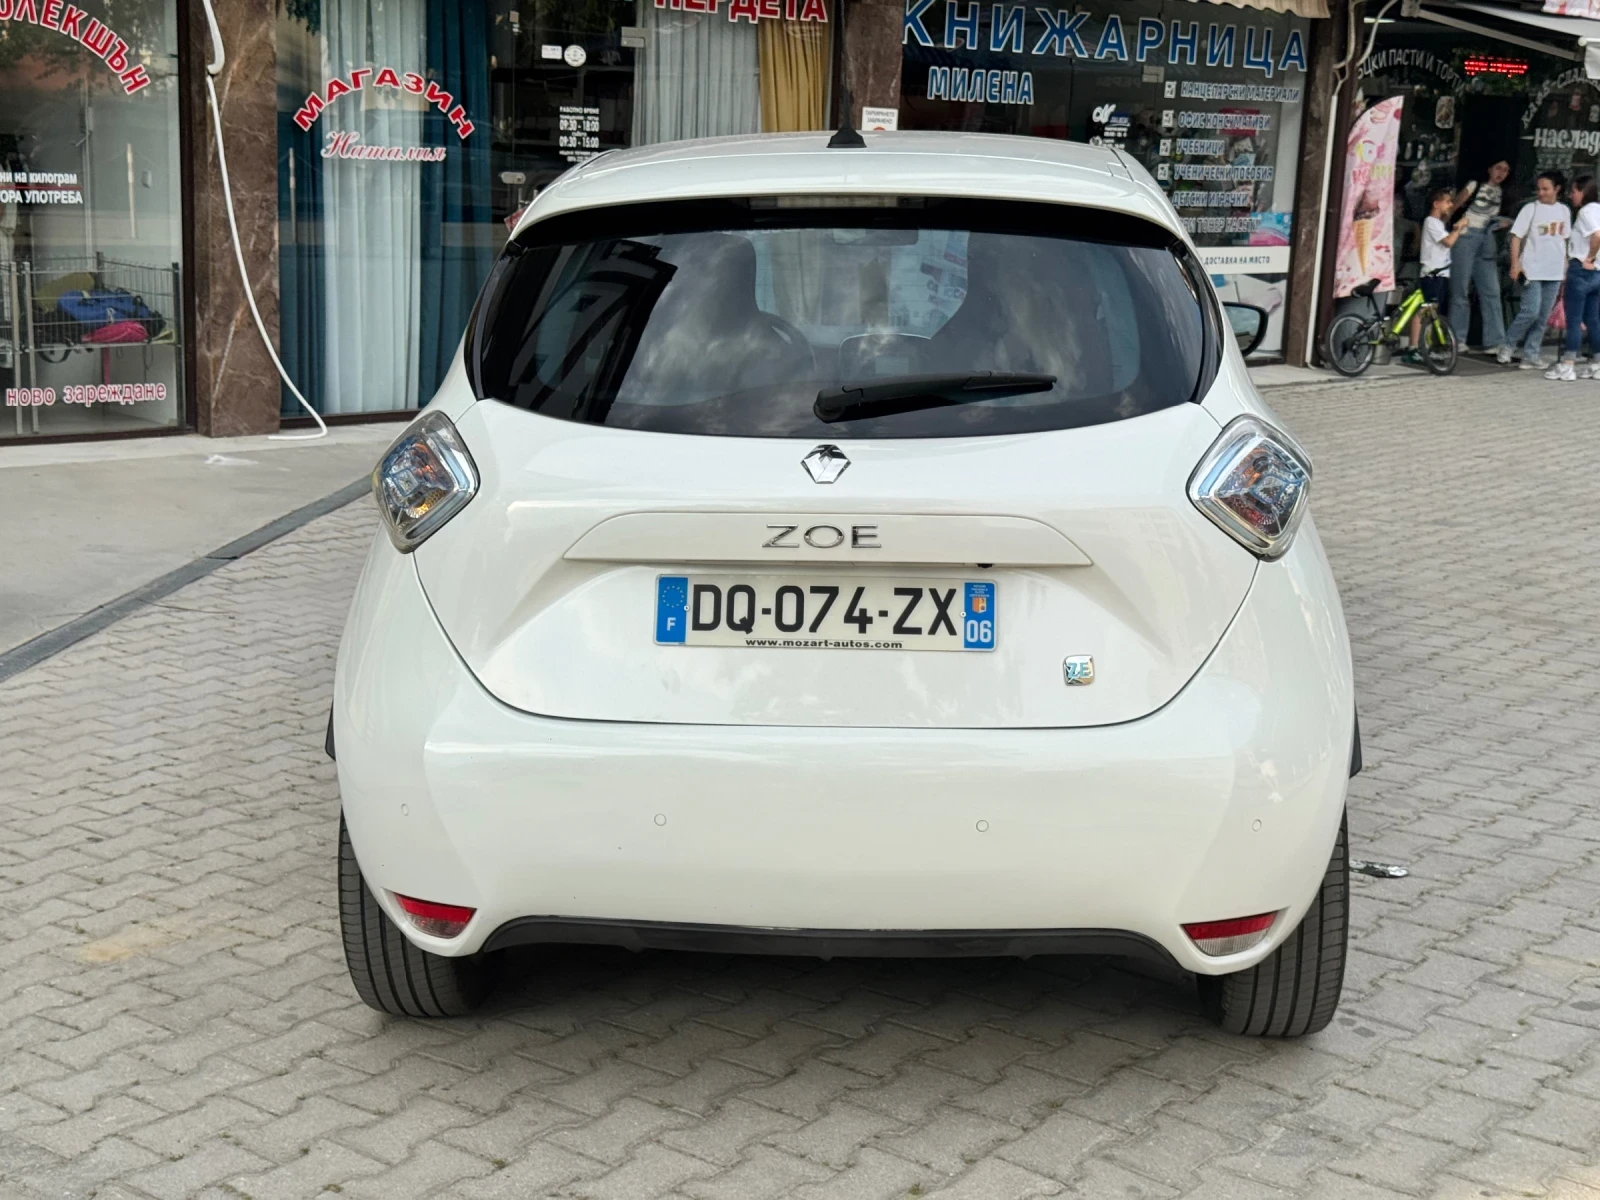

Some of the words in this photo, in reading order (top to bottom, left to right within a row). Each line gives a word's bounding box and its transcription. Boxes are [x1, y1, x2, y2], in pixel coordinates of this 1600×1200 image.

[902, 0, 1307, 78] КНИЖАРНИЦА
[1389, 49, 1424, 69] ПАСТИ
[927, 66, 1034, 105] МИЛЕНА
[1181, 81, 1247, 101] КАНЦЕЛАРСКИ
[1247, 85, 1300, 103] МАТЕРИАЛИ
[293, 67, 475, 140] МАГАЗИН
[1178, 111, 1206, 129] ОФИС
[1206, 113, 1271, 131] КОНСУМАТИВИ
[321, 130, 446, 162] Наталия
[1176, 139, 1225, 158] УЧЕБНИЦИ
[14, 172, 27, 183] на
[29, 173, 78, 187] килограм
[1174, 164, 1233, 180] УЧЕНИЧЕСКИ
[1232, 165, 1274, 181] ПОСОБИЯ
[24, 190, 83, 204] УПОТРЕБА
[1172, 191, 1207, 209] ДЕТСКИ
[1208, 191, 1250, 208] ИГРАЧКИ
[1204, 256, 1238, 265] ДОСТАВКА
[1239, 256, 1248, 265] НА
[1249, 256, 1270, 265] МЯСТО
[6, 387, 56, 406] ново
[63, 383, 167, 407] зареждане
[762, 524, 882, 549] ZOE
[666, 617, 676, 631] F
[692, 584, 958, 636] DQ-074-ZX
[966, 620, 992, 643] 06
[745, 639, 903, 649] www.mozart-autos.com
